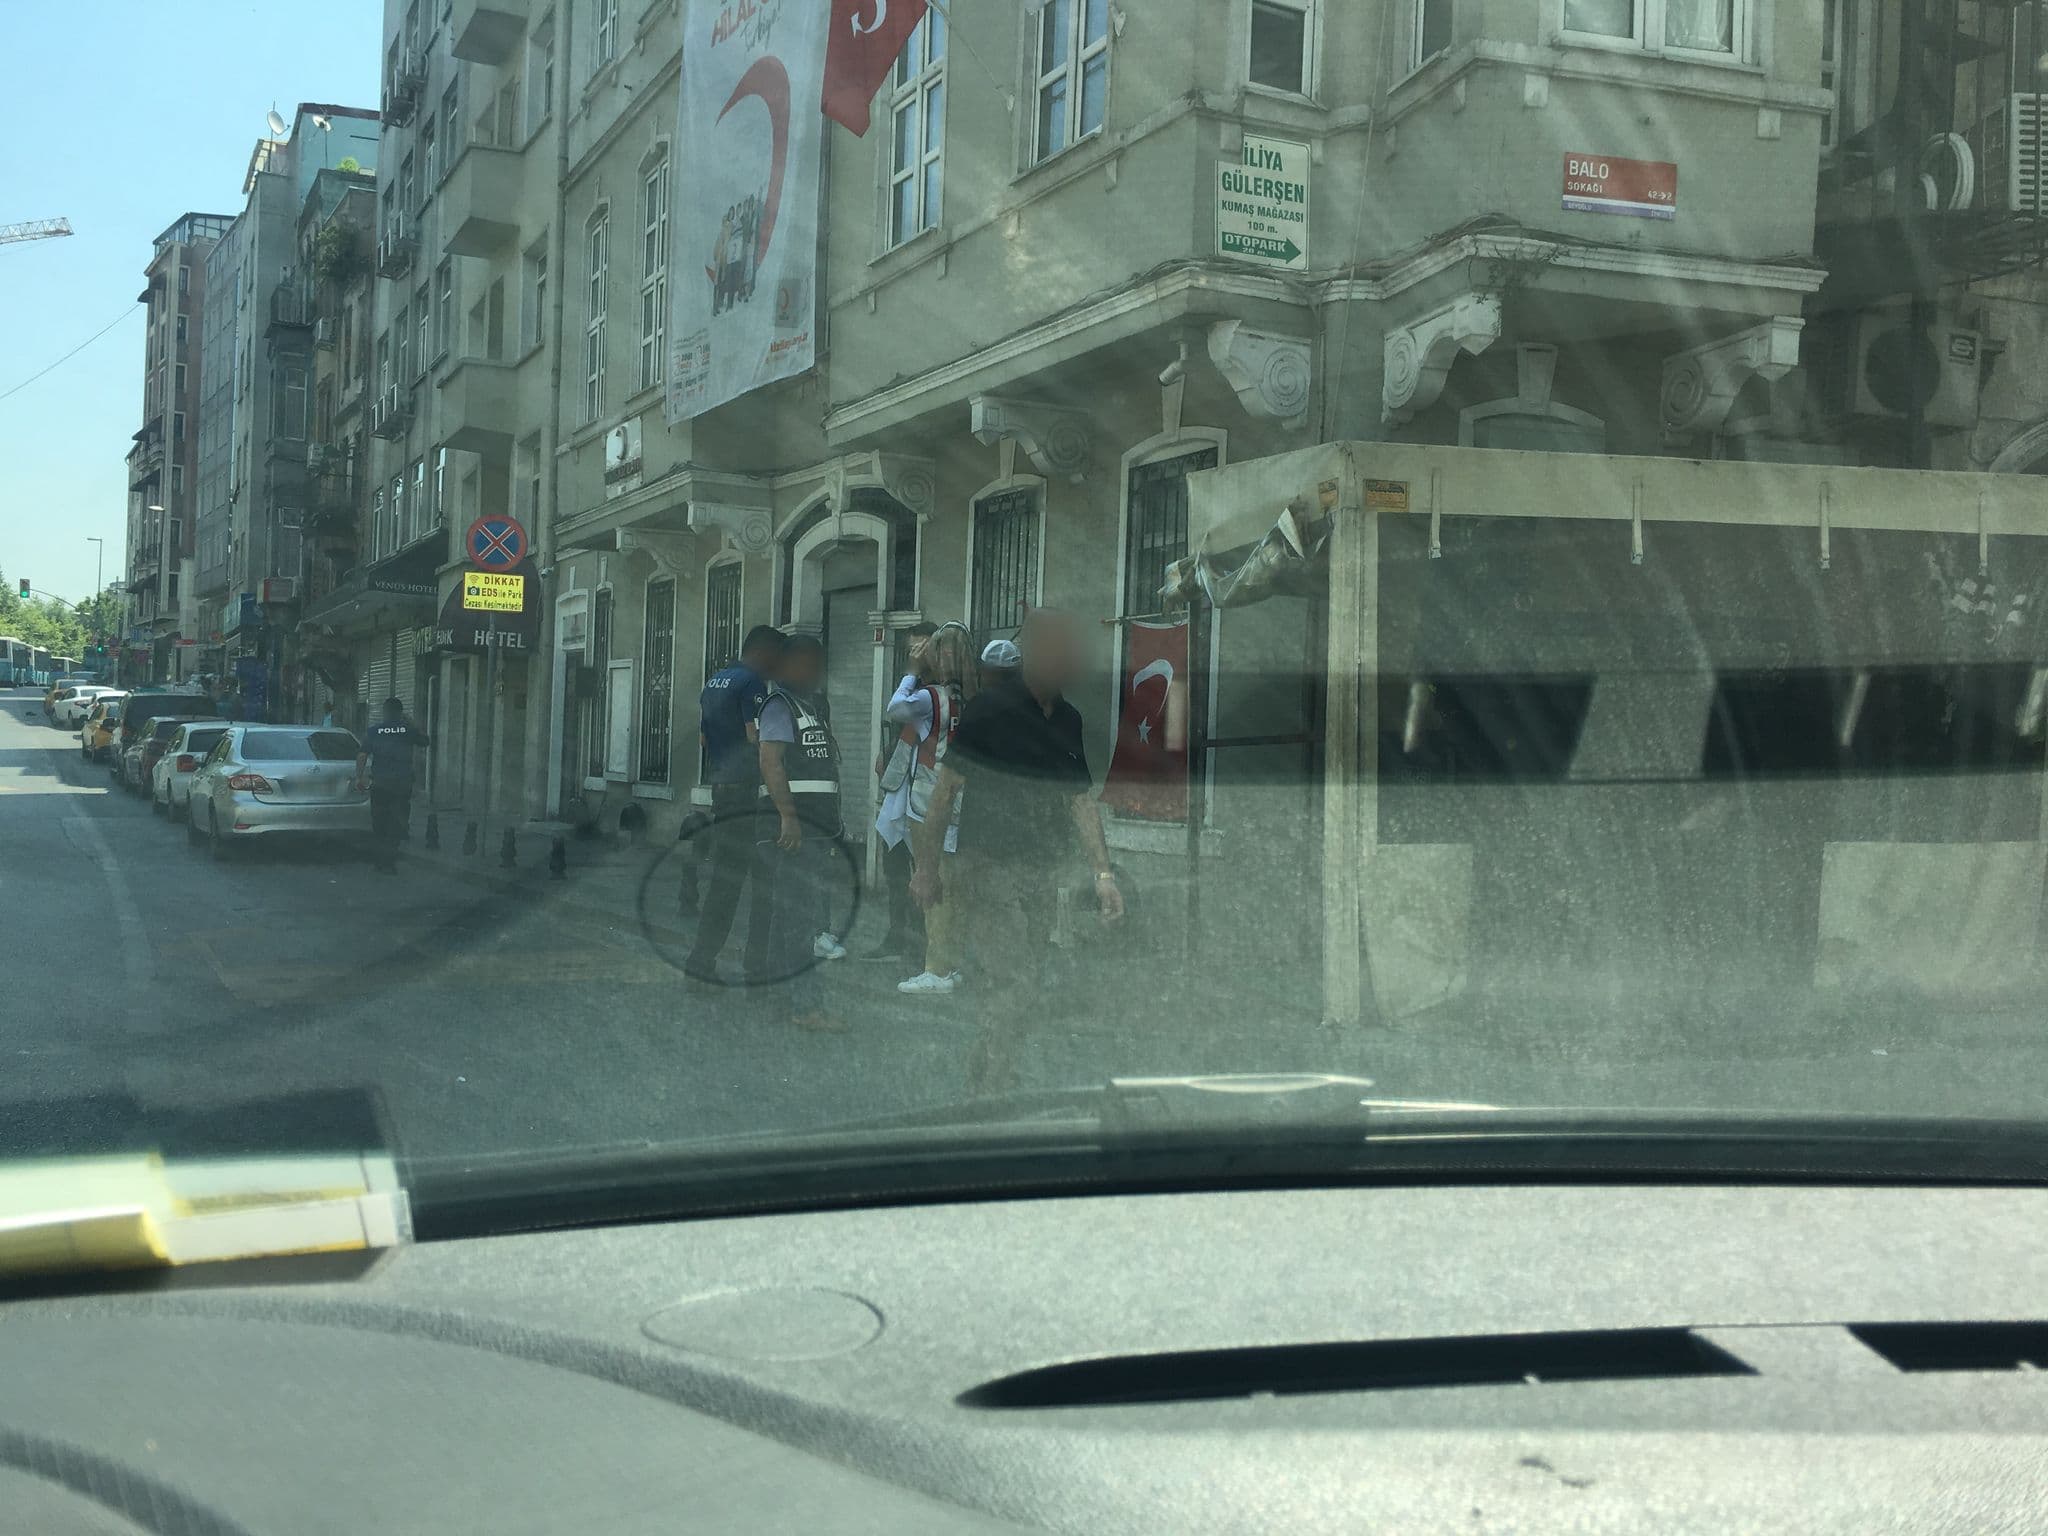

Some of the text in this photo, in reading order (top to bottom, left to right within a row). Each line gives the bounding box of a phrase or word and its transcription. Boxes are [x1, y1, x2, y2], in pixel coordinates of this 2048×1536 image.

[1243, 142, 1283, 172] İLİYA
[1569, 160, 1609, 179] BALO
[1221, 169, 1304, 205] GÜLERŞEN
[1248, 221, 1265, 232] 100
[1224, 234, 1286, 252] OTOPARK
[484, 574, 521, 587] DİKKAT
[481, 588, 498, 598] EDS
